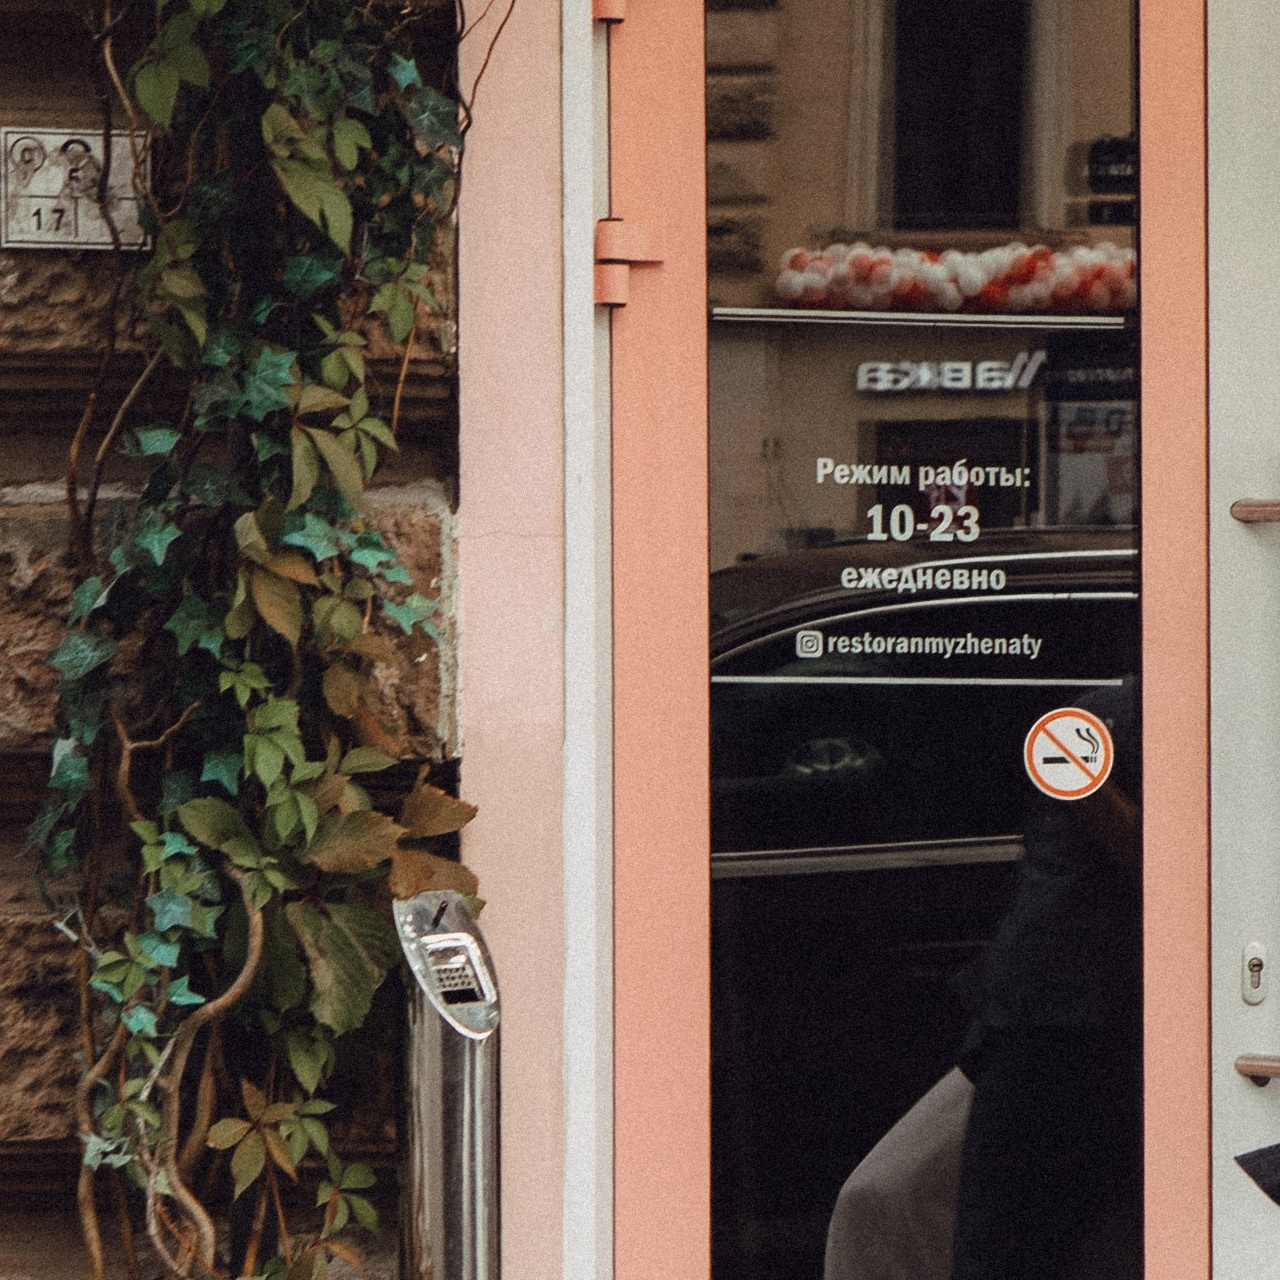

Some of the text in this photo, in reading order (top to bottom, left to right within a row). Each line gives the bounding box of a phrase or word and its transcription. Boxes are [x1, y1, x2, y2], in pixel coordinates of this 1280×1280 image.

[32, 207, 66, 231] 17
[816, 457, 1031, 491] Режим работы:
[866, 504, 981, 543] 10-23
[840, 566, 1007, 594] ежедневно
[827, 631, 1043, 660] restoranmyzhenaty
